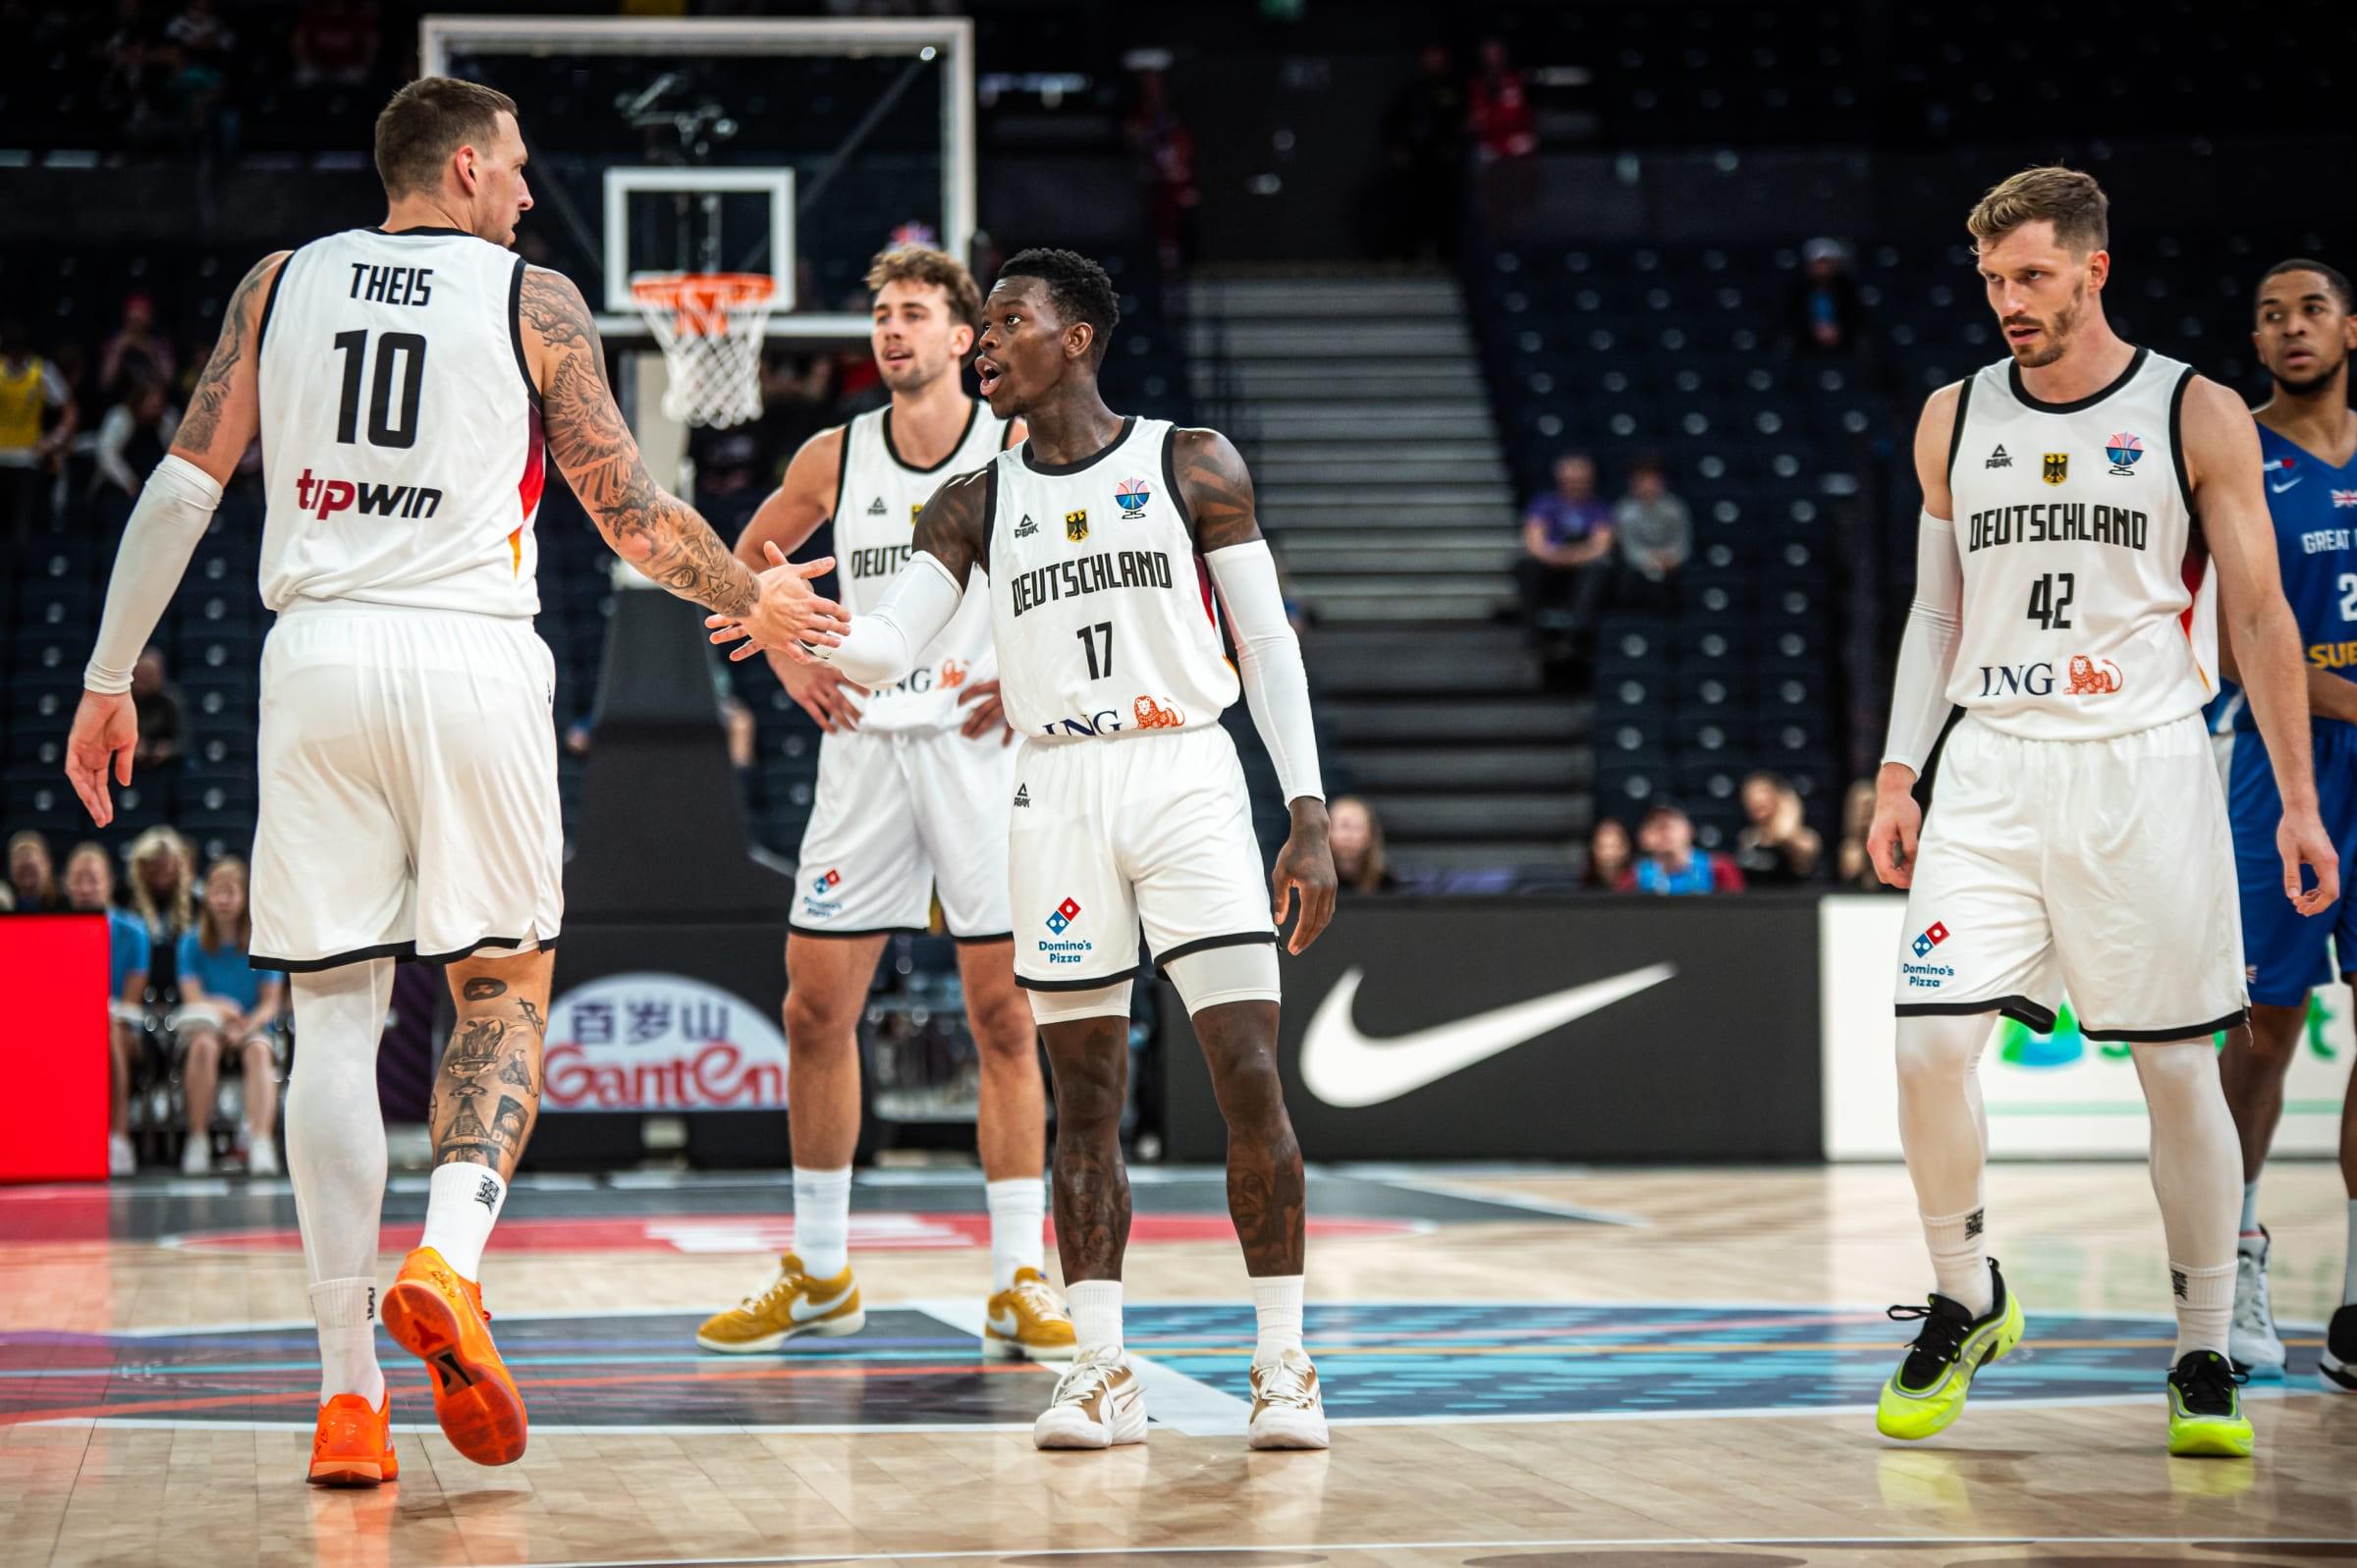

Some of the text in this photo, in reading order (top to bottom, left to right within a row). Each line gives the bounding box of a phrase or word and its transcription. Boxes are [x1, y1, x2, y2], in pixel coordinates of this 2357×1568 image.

[350, 263, 433, 306] THEIS
[334, 329, 426, 449] 10
[297, 468, 442, 520] tipwin
[1969, 503, 2148, 553] DEUTSCHLAND
[2301, 529, 2350, 554] GREAT
[1012, 551, 1173, 618] DEUTSCHLAND
[2027, 572, 2074, 630] 42
[1076, 621, 1113, 680] 17
[1979, 663, 2056, 697] ING
[1038, 940, 1092, 951] Domino's
[1049, 952, 1081, 963] Pizza
[1902, 963, 1954, 976] Domino's
[1909, 976, 1941, 987] Pizza
